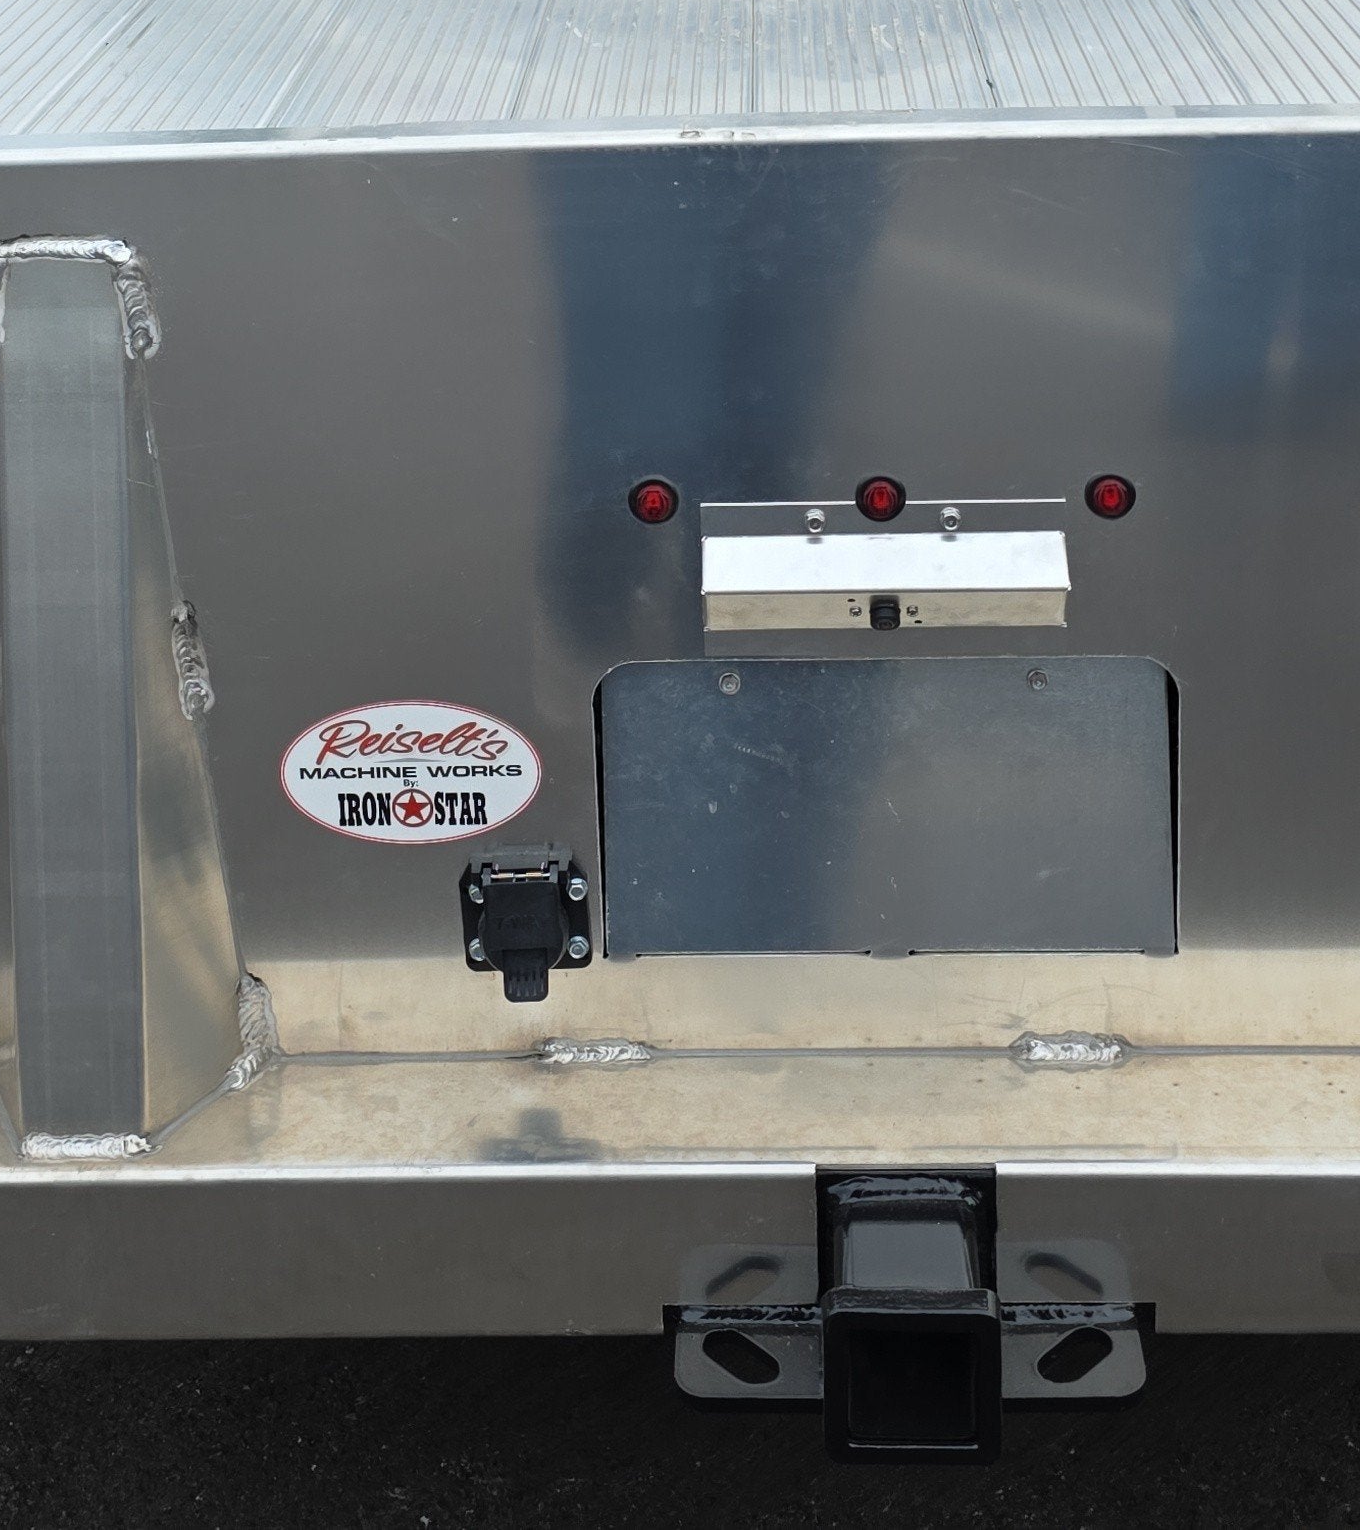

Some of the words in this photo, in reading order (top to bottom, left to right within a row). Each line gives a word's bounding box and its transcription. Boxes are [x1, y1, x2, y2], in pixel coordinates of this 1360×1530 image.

[316, 719, 508, 765] Reiselt's
[299, 766, 417, 780] MACHINE
[426, 764, 522, 778] WORKS
[403, 779, 419, 787] By:
[338, 791, 391, 827] IRON
[434, 791, 488, 826] STAR
